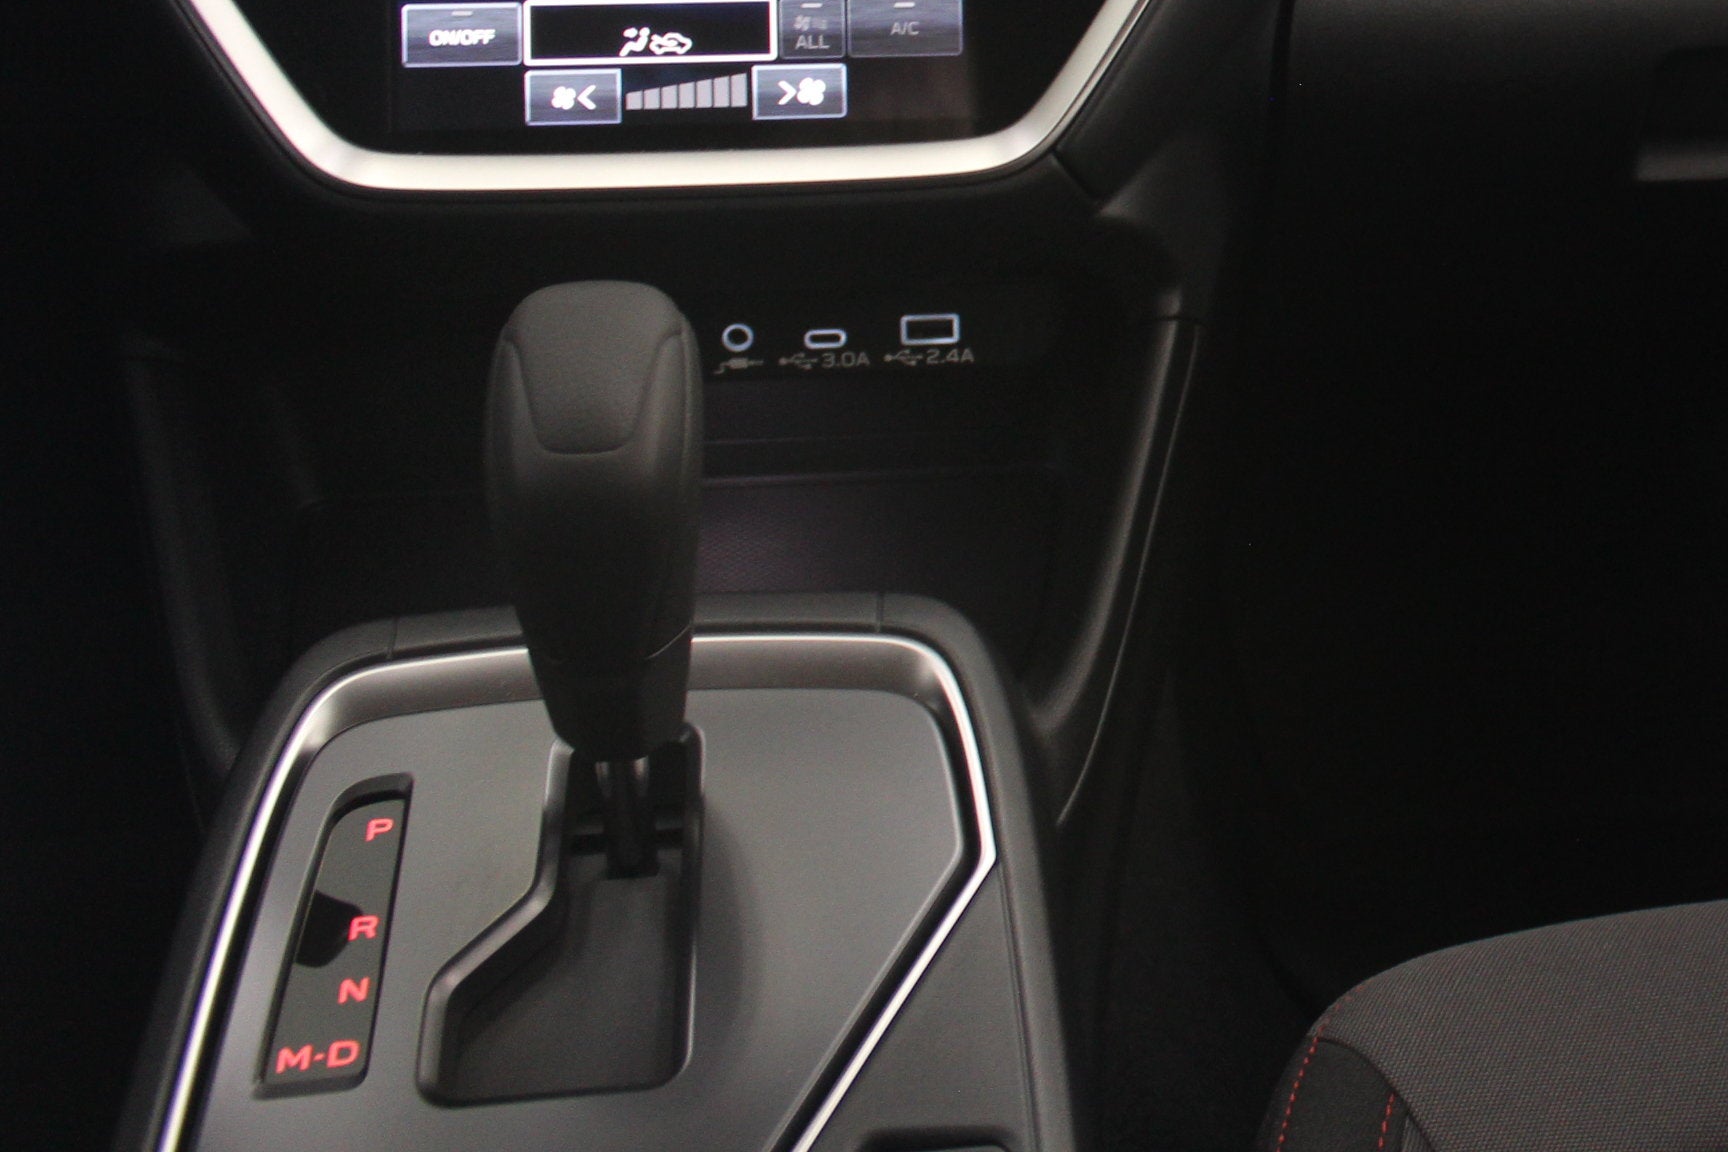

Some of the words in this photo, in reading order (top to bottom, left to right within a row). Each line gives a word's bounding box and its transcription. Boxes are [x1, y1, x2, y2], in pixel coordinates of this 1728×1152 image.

[429, 28, 496, 47] ON/OFF
[890, 21, 920, 36] A/C
[795, 34, 830, 50] ALL
[821, 351, 870, 369] 3.0A
[926, 347, 975, 365] 2.4A
[365, 818, 394, 842] P
[349, 914, 380, 941] R
[337, 977, 370, 1004] N
[275, 1039, 362, 1074] M-D
